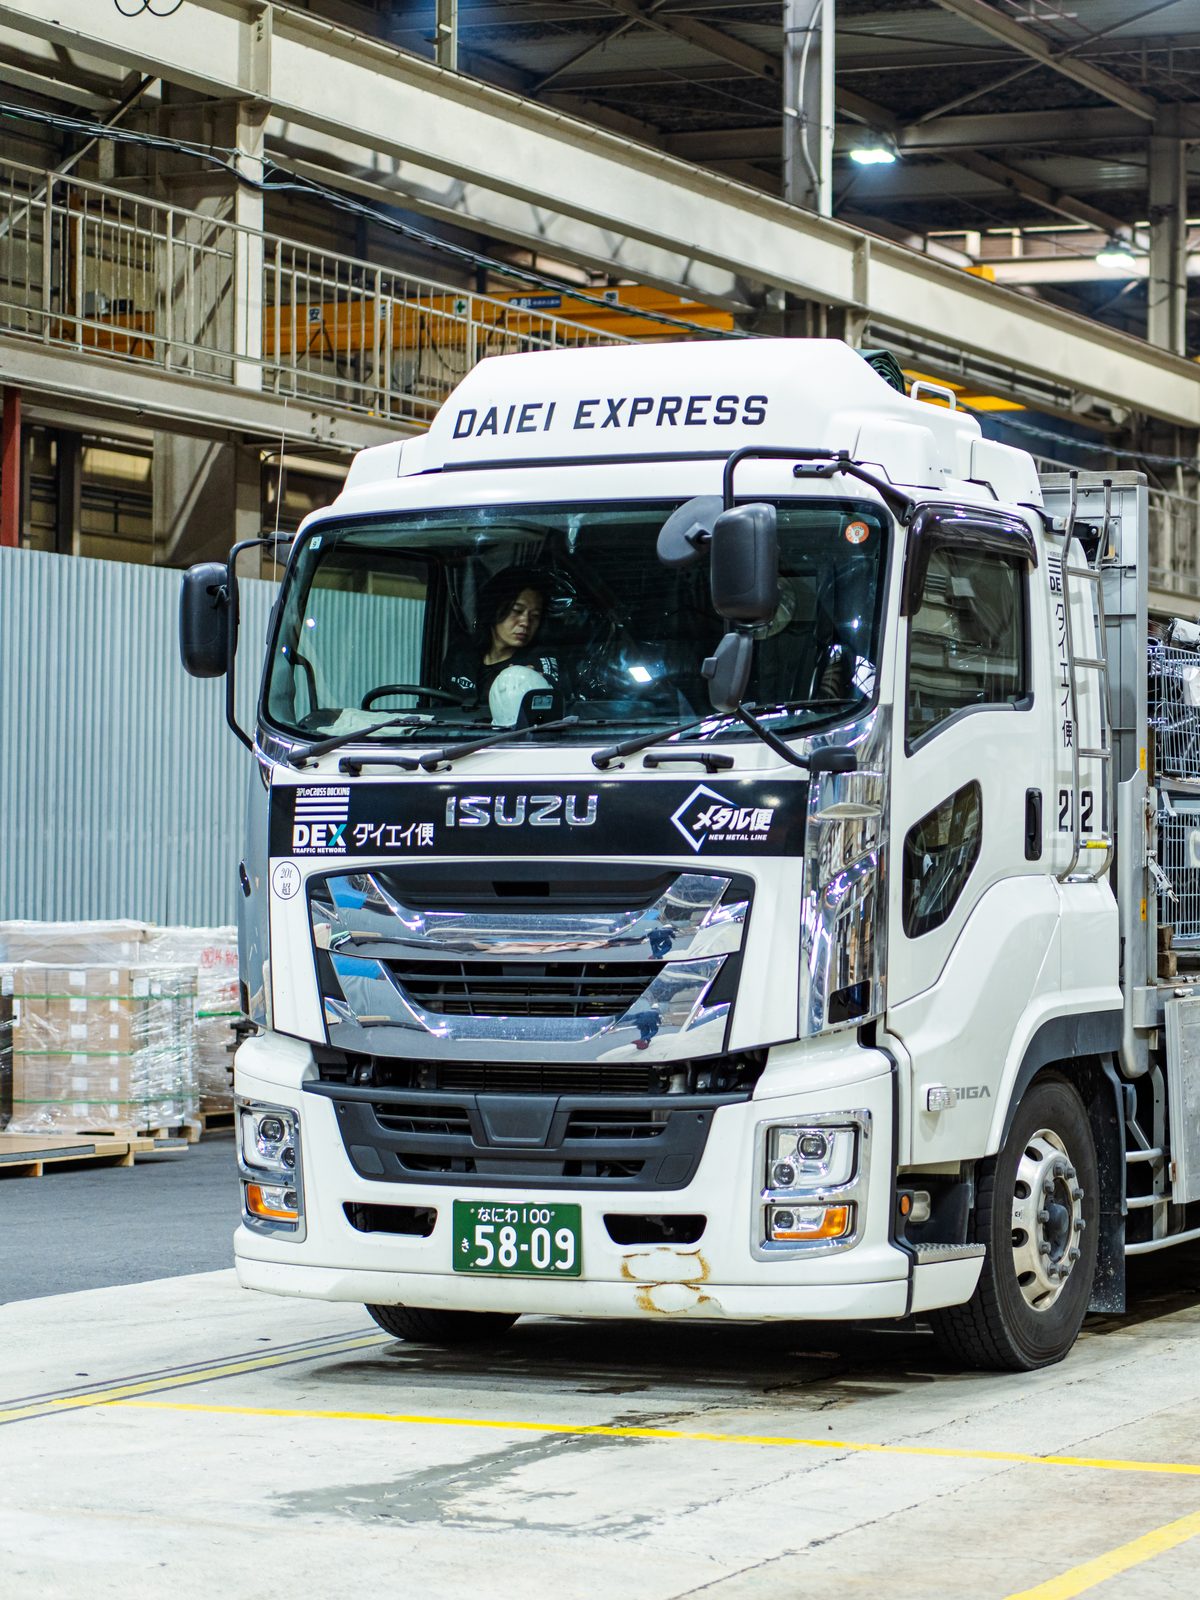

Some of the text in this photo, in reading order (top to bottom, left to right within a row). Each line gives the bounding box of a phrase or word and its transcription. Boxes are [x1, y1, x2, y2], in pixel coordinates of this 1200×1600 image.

[452, 395, 768, 439] DAIEI EXPRESS
[1050, 575, 1062, 592] DE
[445, 795, 598, 827] ISUZU
[692, 805, 774, 831] メタル便
[1058, 789, 1093, 833] 22
[292, 823, 347, 848] DEX
[353, 823, 434, 847] ダイエイ便
[477, 1206, 551, 1225] なにわ 100
[460, 1224, 575, 1270] き 58-09
